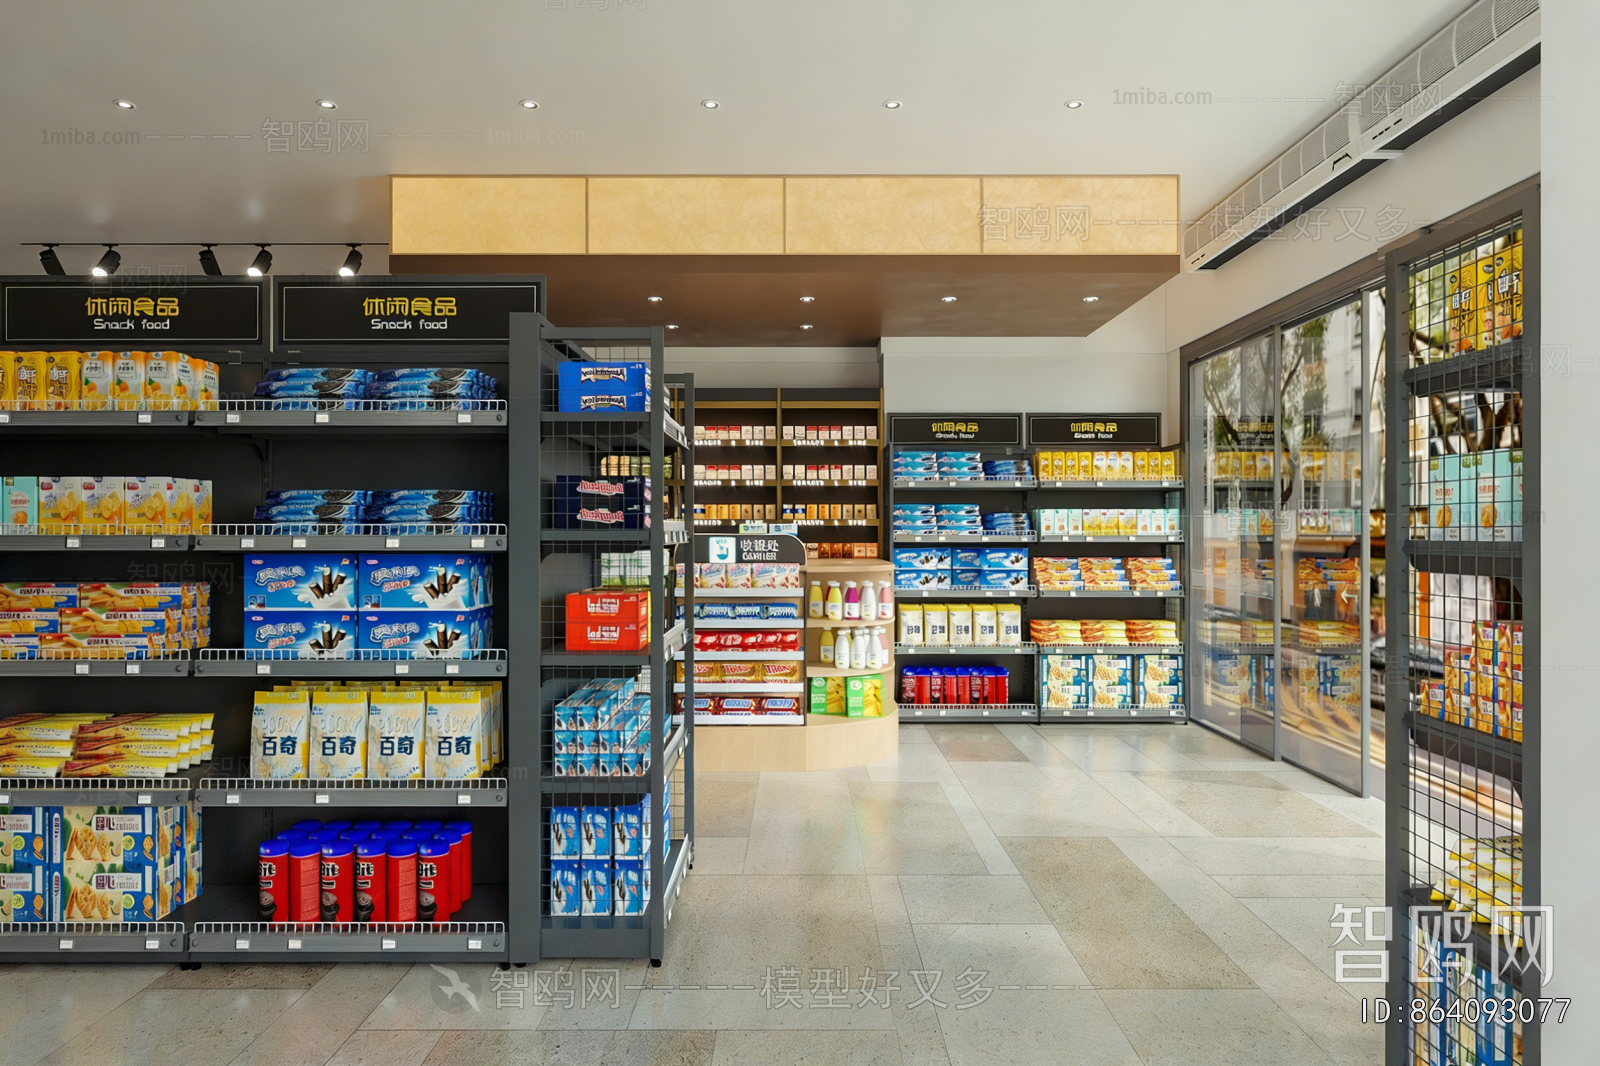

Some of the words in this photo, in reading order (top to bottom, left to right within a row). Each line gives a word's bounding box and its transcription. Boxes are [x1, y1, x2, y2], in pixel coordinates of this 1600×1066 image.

[85, 297, 180, 317] 休闲食品
[363, 297, 458, 317] 休闲食品
[93, 318, 134, 330] Snack
[142, 318, 170, 330] food
[371, 318, 412, 330] Snack
[420, 318, 448, 330] food
[262, 735, 297, 756] 百奇
[322, 735, 356, 756] 百奇
[380, 735, 414, 756] 百奇
[438, 735, 472, 756] 百奇
